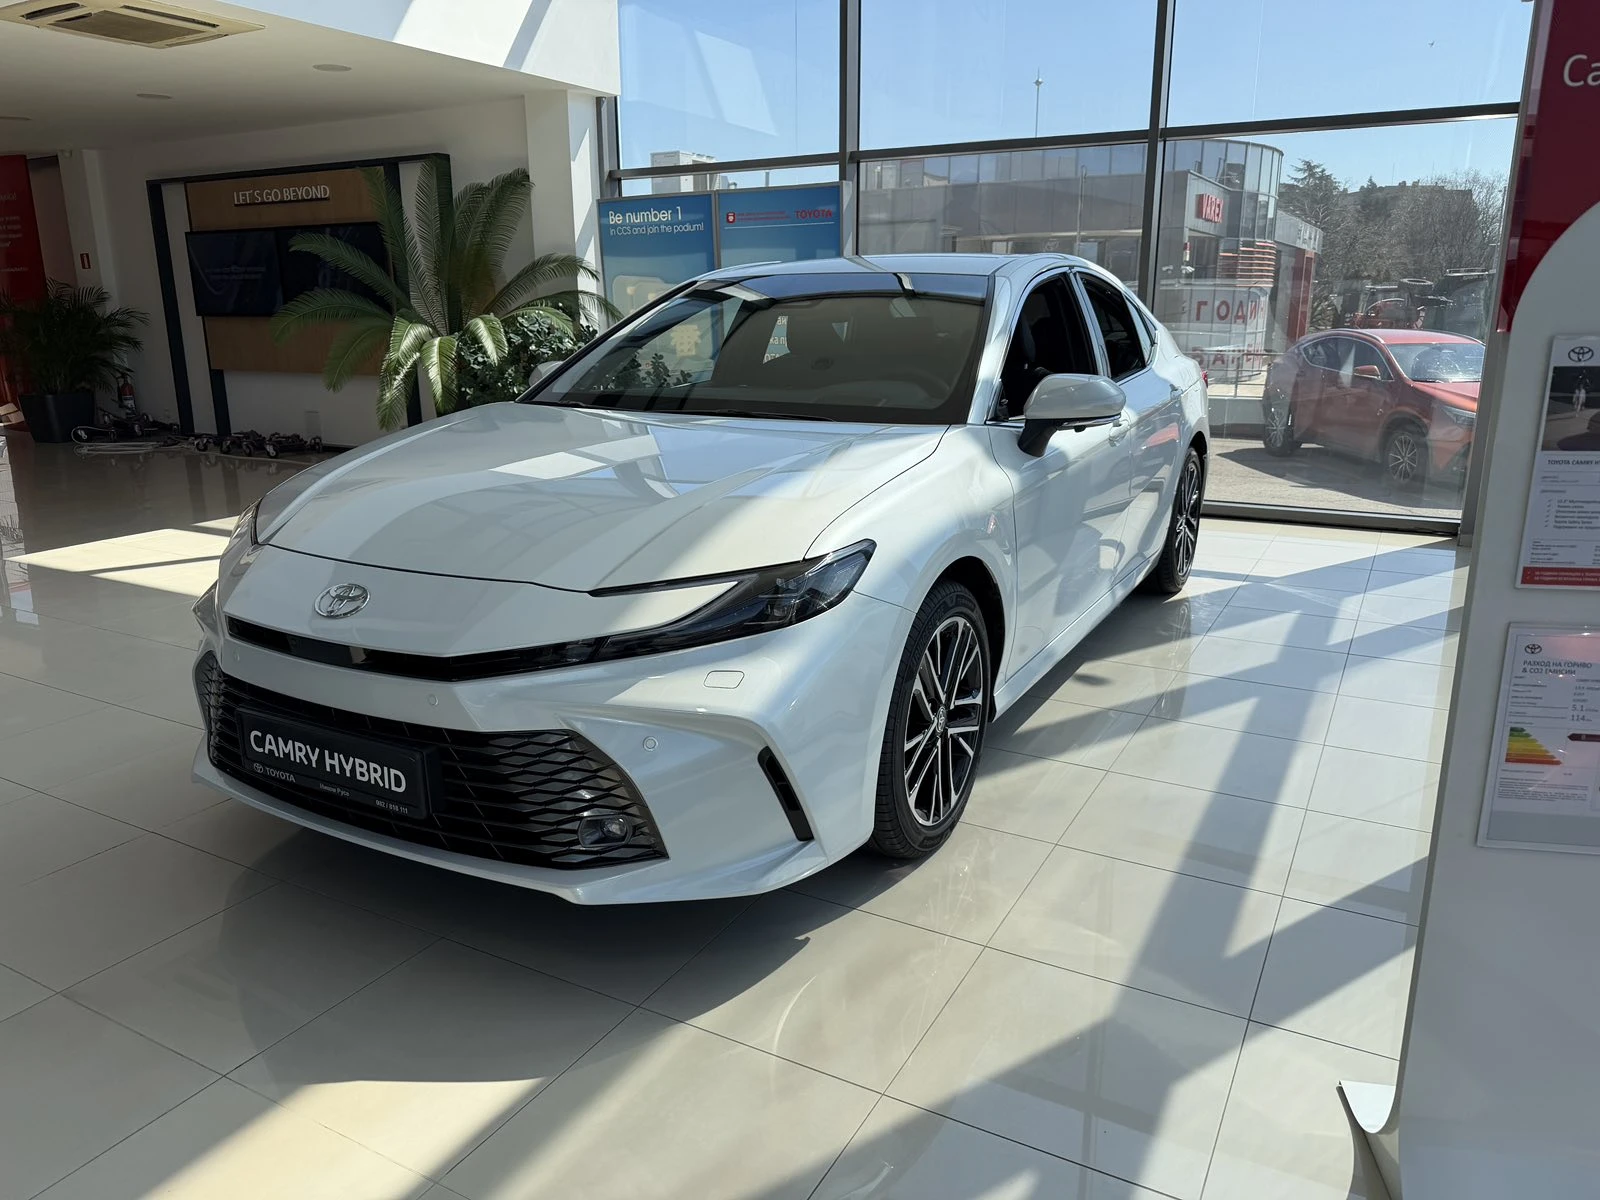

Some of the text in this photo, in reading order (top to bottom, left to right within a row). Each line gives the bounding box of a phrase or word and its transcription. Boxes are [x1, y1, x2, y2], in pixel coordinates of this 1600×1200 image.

[263, 189, 281, 202] GO
[283, 185, 330, 201] BEYOND
[795, 209, 833, 219] TOYOTA
[1202, 193, 1224, 223] VAREX
[609, 206, 682, 225] Be number 1
[616, 227, 632, 235] CCS
[633, 225, 646, 234] and
[647, 224, 660, 235] join
[660, 224, 672, 233] the
[673, 222, 704, 234] podium!
[1523, 660, 1551, 668] РАЗХОД
[1571, 704, 1584, 712] 5.1
[1570, 714, 1586, 722] 114
[249, 730, 407, 793] CAMRY HYBRID
[265, 767, 296, 783] TOYOTA
